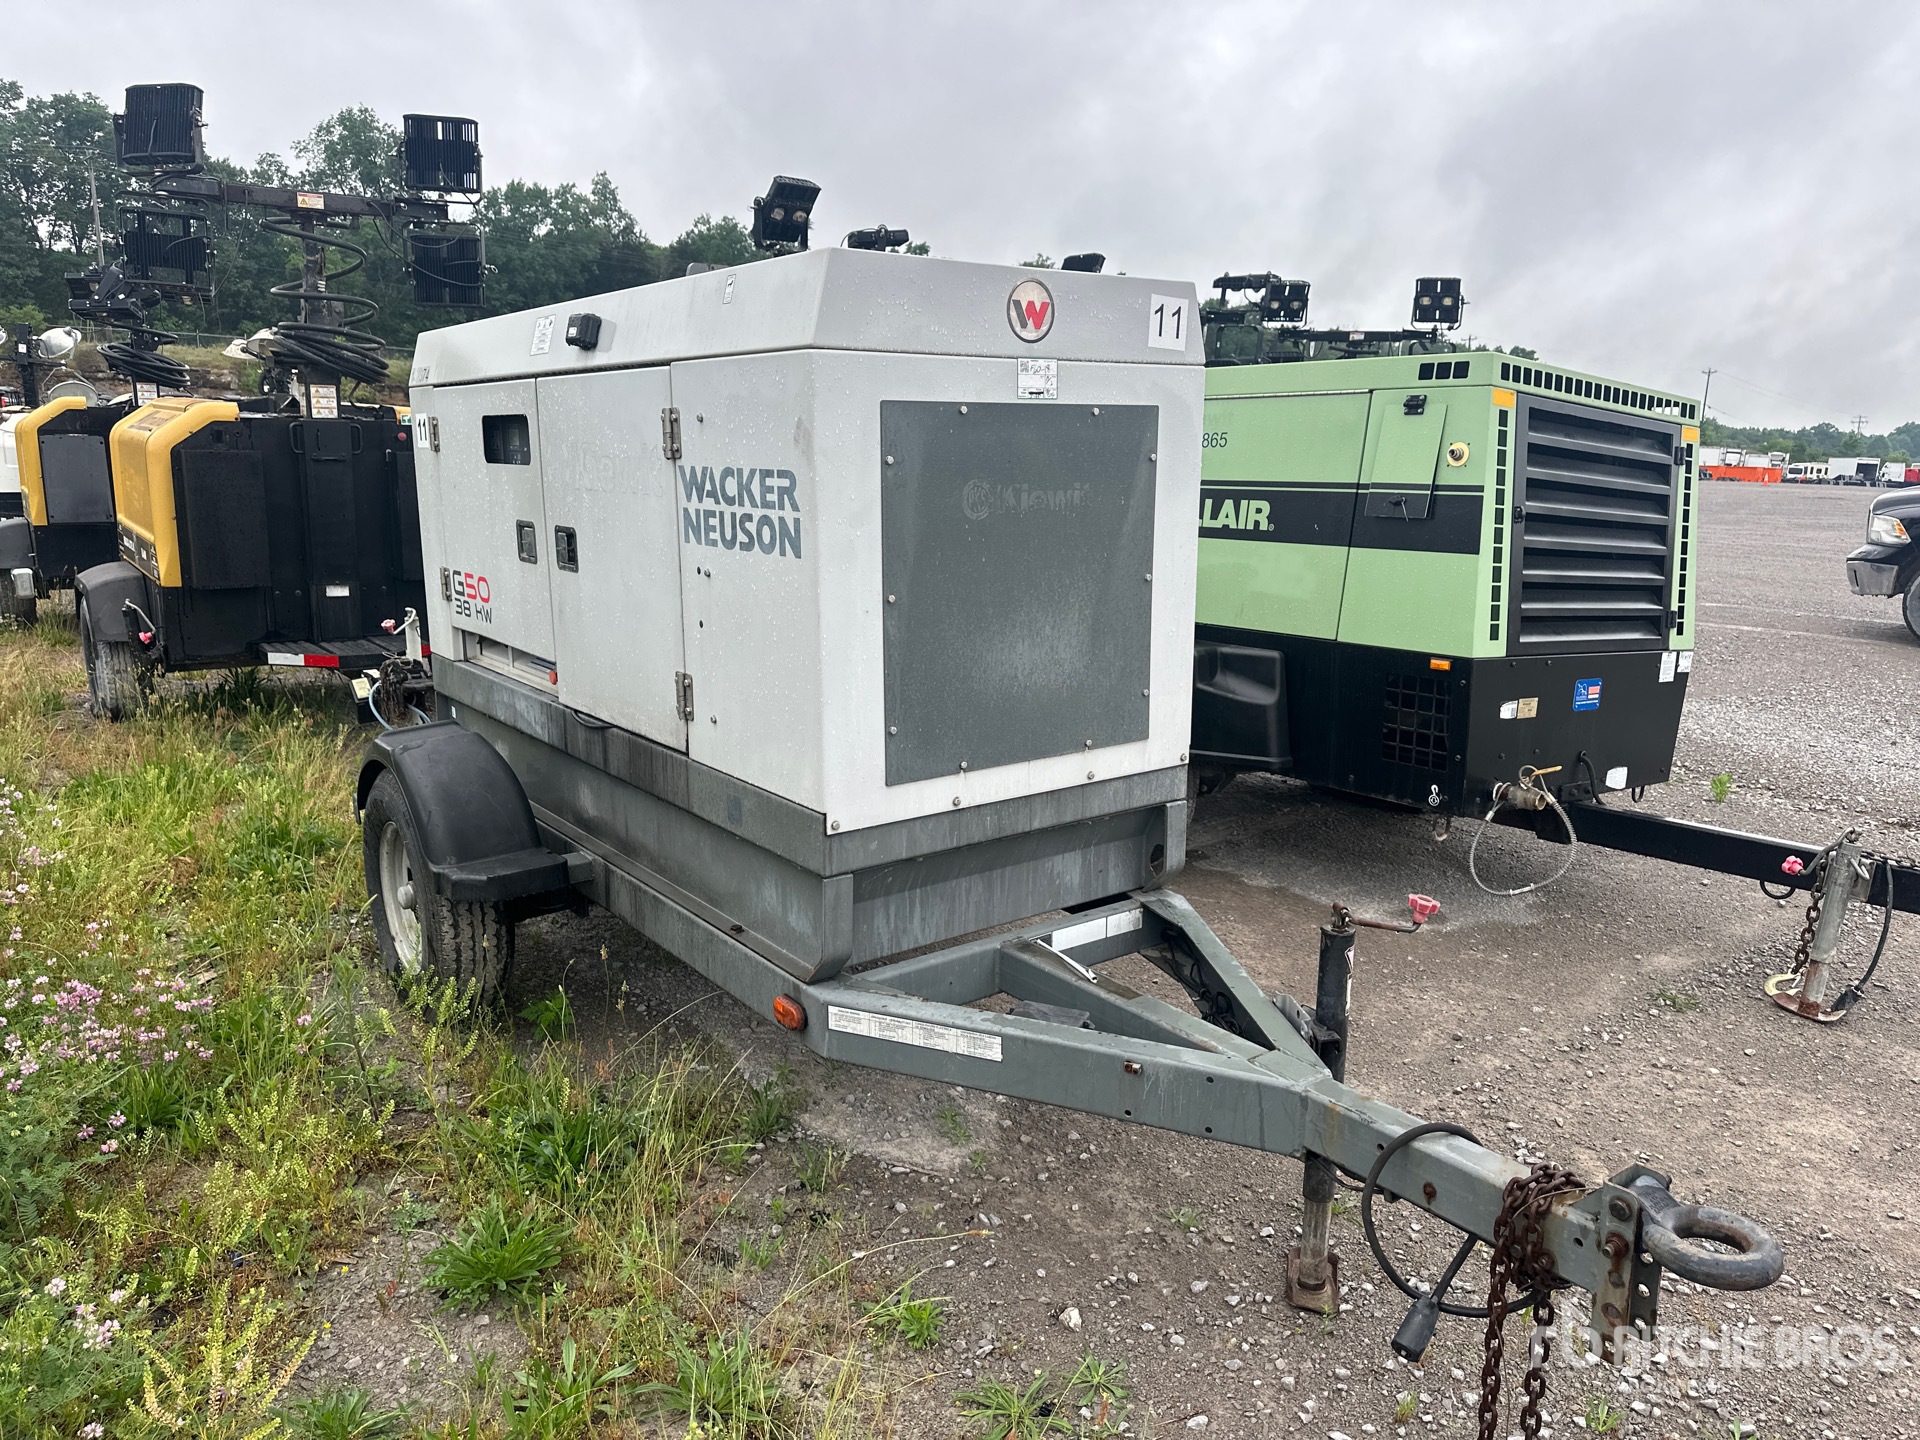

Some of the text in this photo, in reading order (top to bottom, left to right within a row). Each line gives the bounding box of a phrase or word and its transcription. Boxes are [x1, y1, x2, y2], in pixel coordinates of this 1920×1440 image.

[1153, 303, 1182, 340] 11
[417, 418, 428, 442] 11
[1201, 431, 1228, 449] 865
[677, 464, 801, 513] WACKER
[1199, 498, 1271, 531] LAIR
[682, 506, 802, 560] NEUSON
[452, 569, 491, 604] G50
[454, 597, 472, 618] 38
